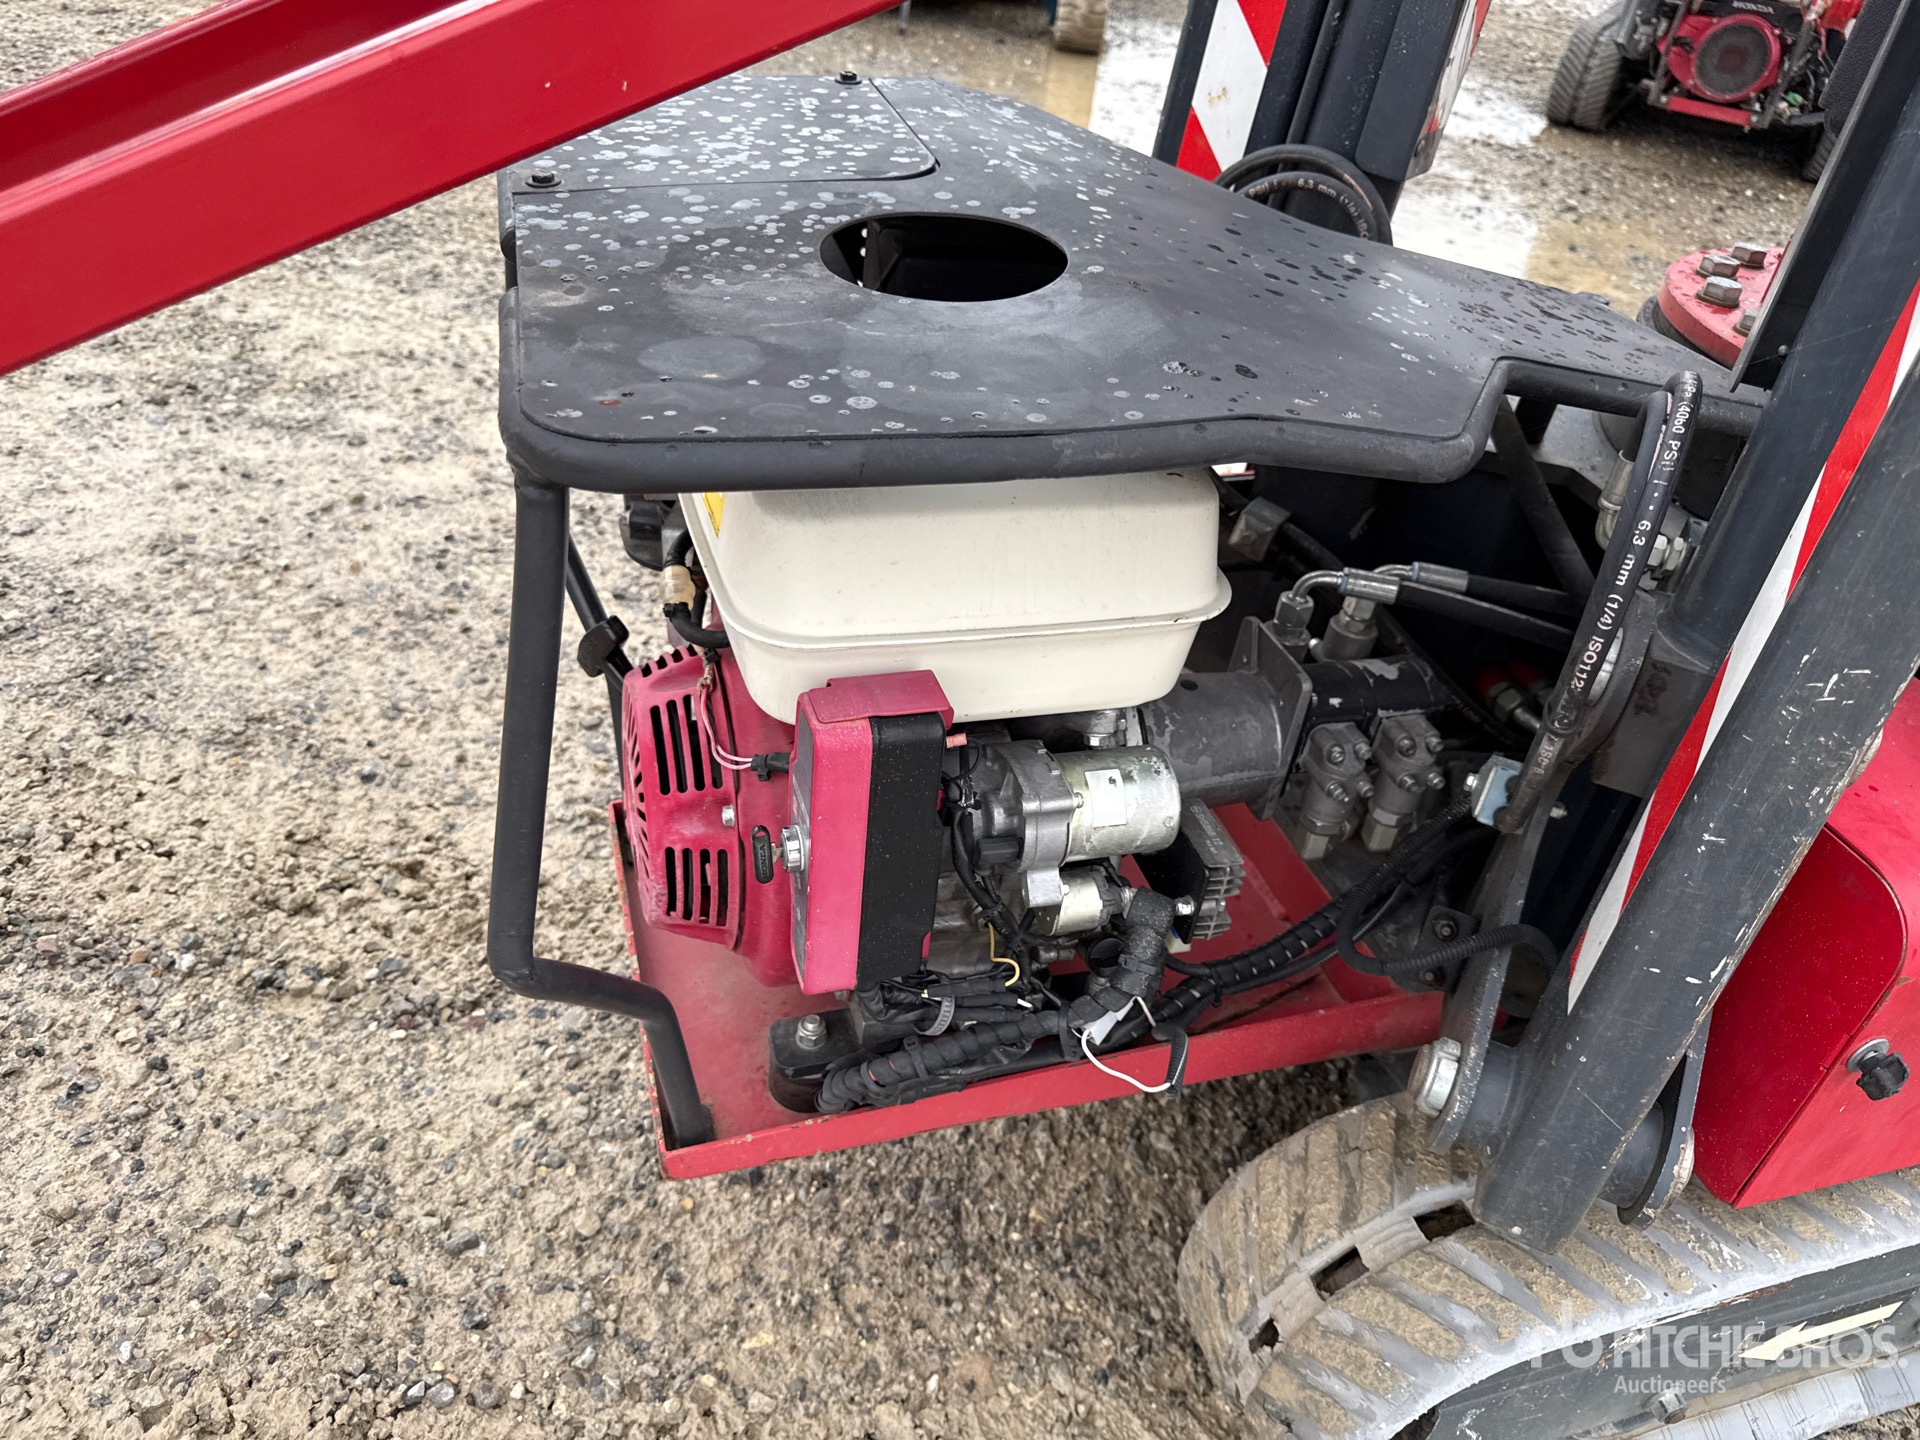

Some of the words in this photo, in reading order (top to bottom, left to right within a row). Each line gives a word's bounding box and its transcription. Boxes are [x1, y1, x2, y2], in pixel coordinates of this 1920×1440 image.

[1297, 178, 1314, 189] 6,3
[1317, 184, 1337, 198] mm
[1672, 401, 1694, 434] (4060
[1632, 519, 1651, 546] 6,3
[1615, 553, 1635, 586] mm
[1596, 593, 1624, 631] (1/4)
